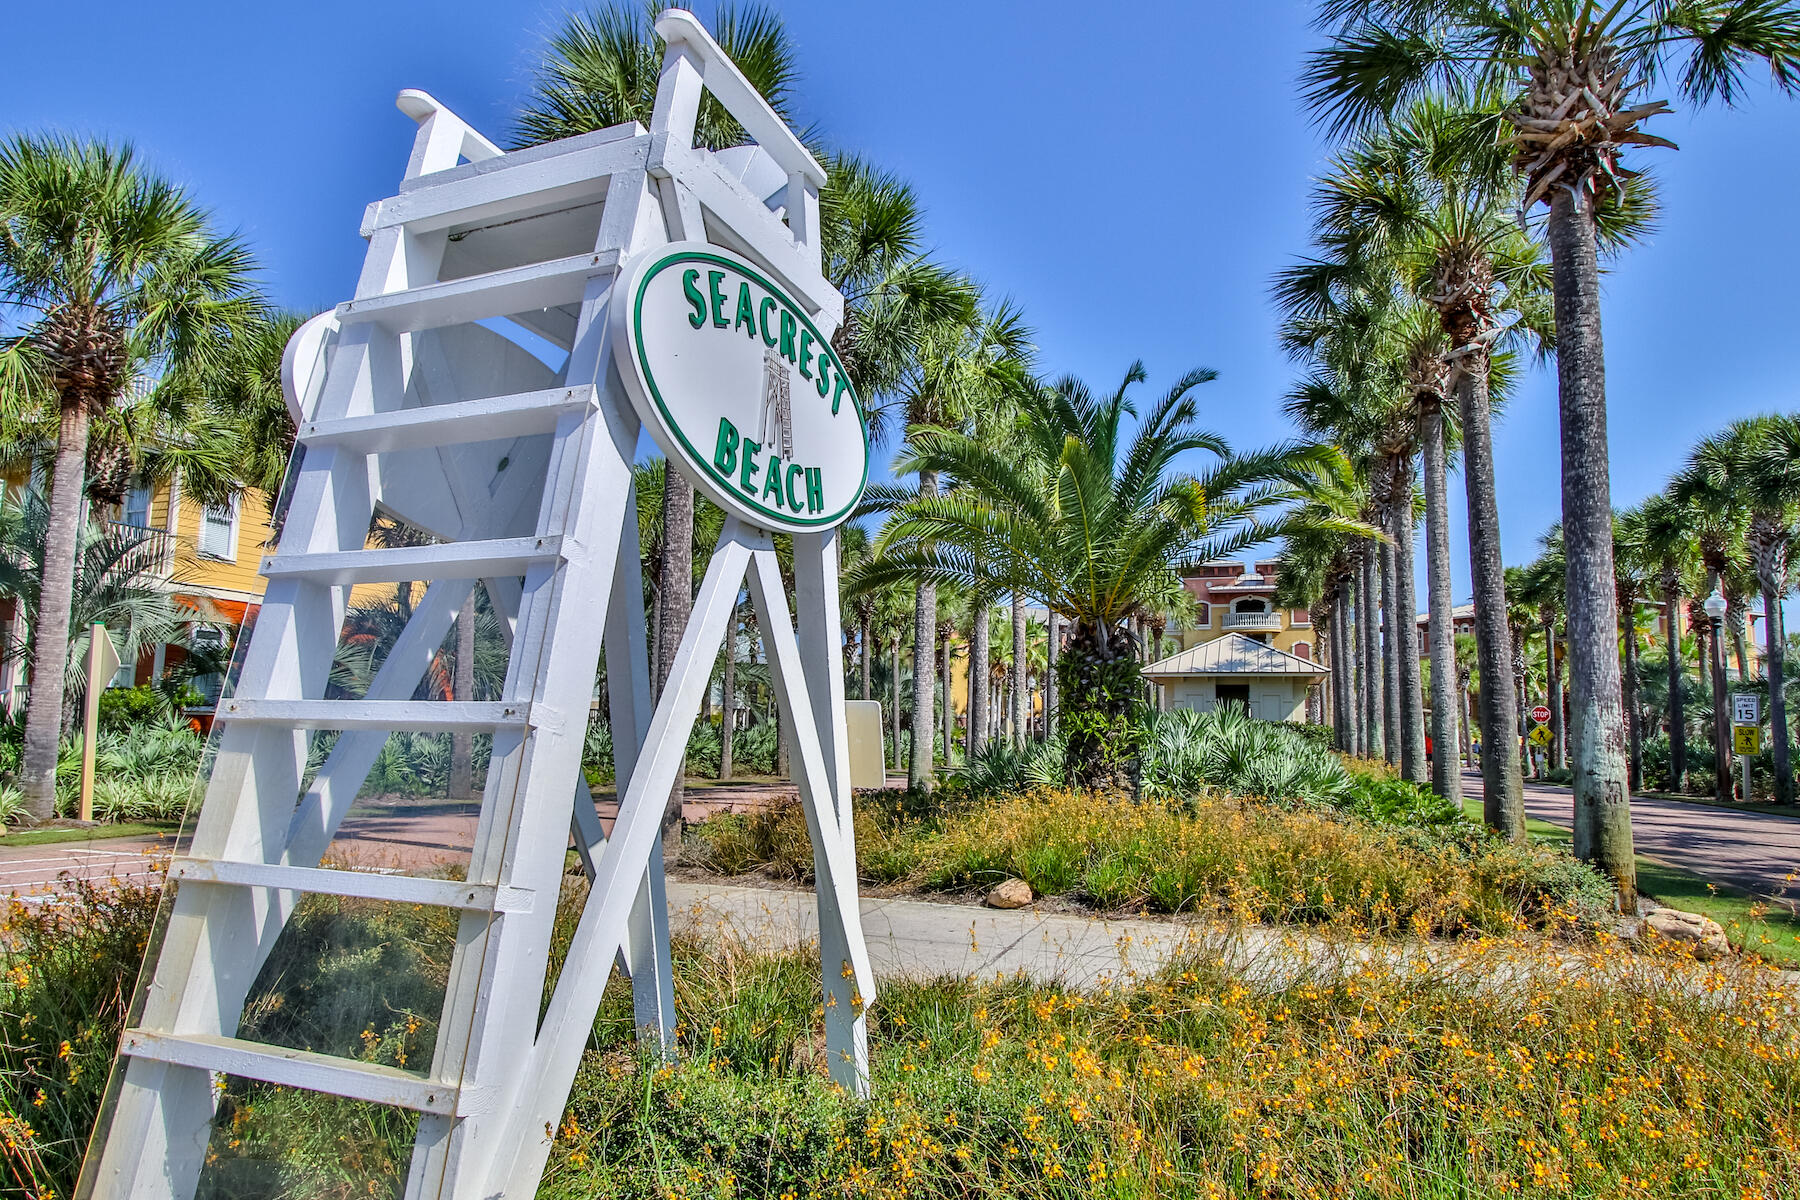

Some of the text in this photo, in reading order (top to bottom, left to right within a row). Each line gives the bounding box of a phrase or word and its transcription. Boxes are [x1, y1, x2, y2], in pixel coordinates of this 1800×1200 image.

[683, 269, 846, 416] SEACREST
[714, 417, 824, 514] BEACH
[1738, 710, 1754, 720] 15
